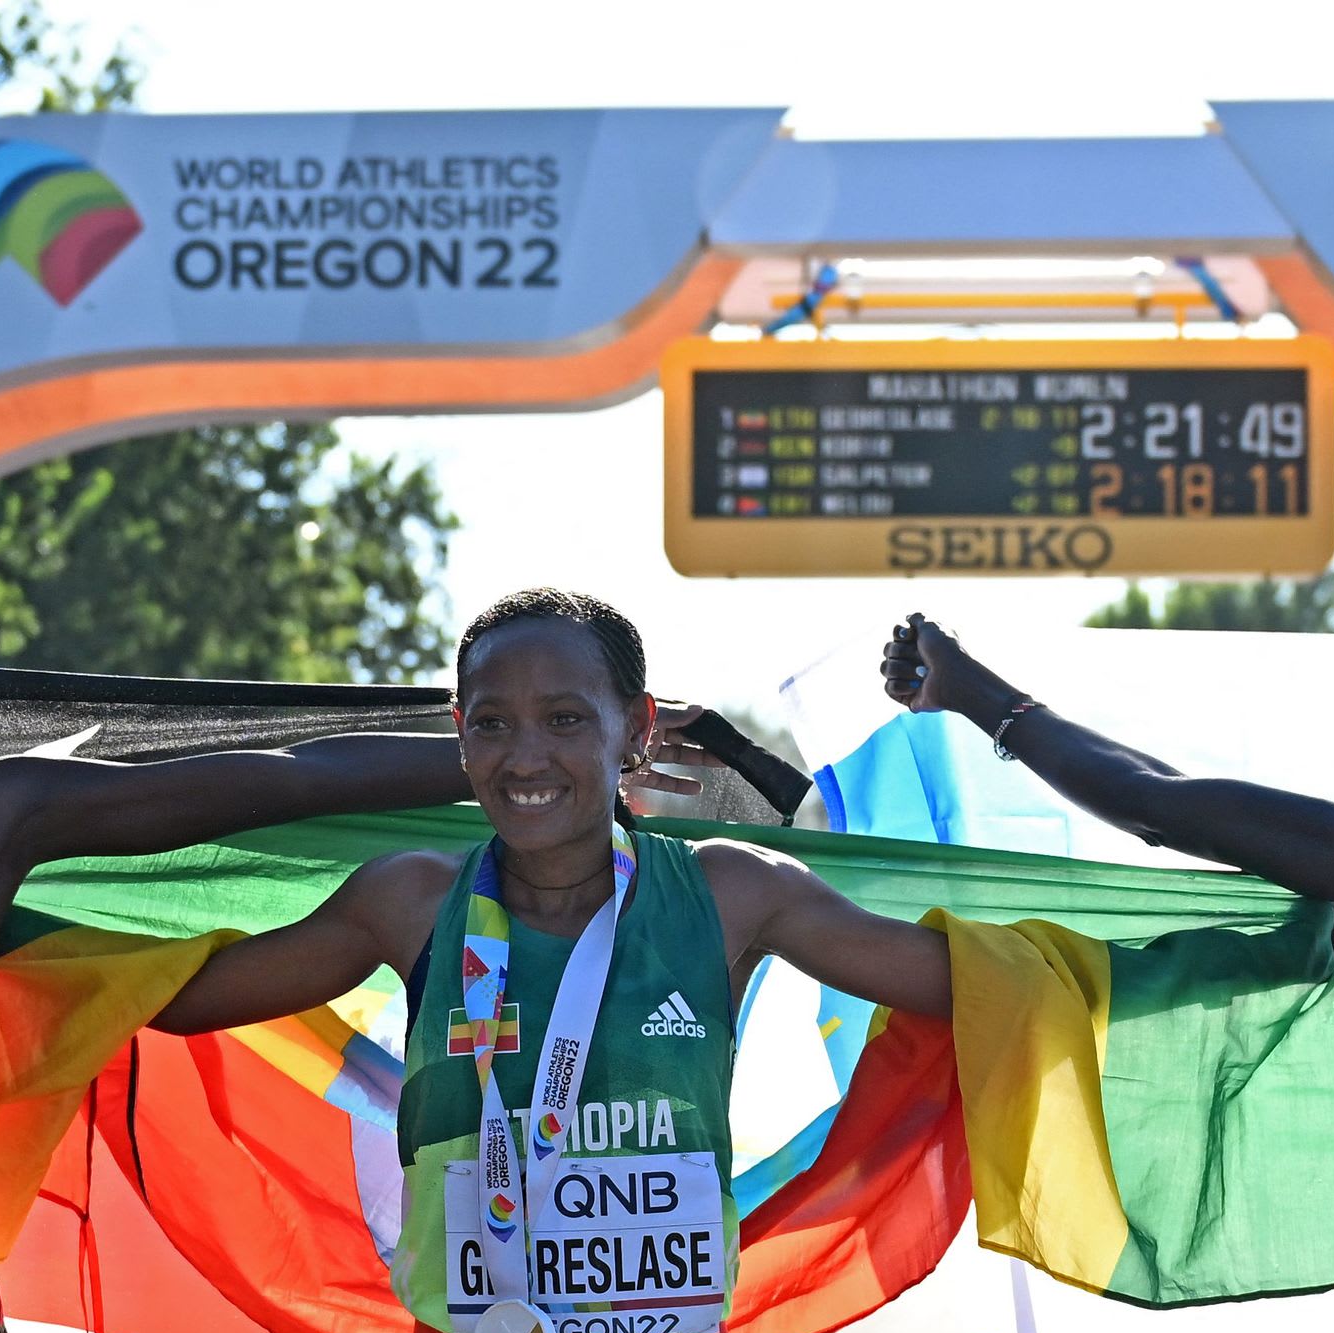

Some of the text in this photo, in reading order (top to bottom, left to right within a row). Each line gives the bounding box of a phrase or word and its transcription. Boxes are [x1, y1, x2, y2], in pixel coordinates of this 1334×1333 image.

[174, 157, 559, 191] WORLD ATHLETICS
[175, 196, 559, 232] CHAMPIONSHIPS
[868, 374, 1129, 401] MARATHON WOMEN
[1080, 403, 1305, 460] 2:21:49
[1089, 463, 1299, 518] 2:18:11
[888, 523, 1114, 570] SEIKO
[641, 1019, 707, 1039] adidas
[549, 1038, 570, 1108] CHAMPIONSHIPS
[553, 1170, 680, 1219] QNB
[459, 1230, 713, 1297] GRESLASE
